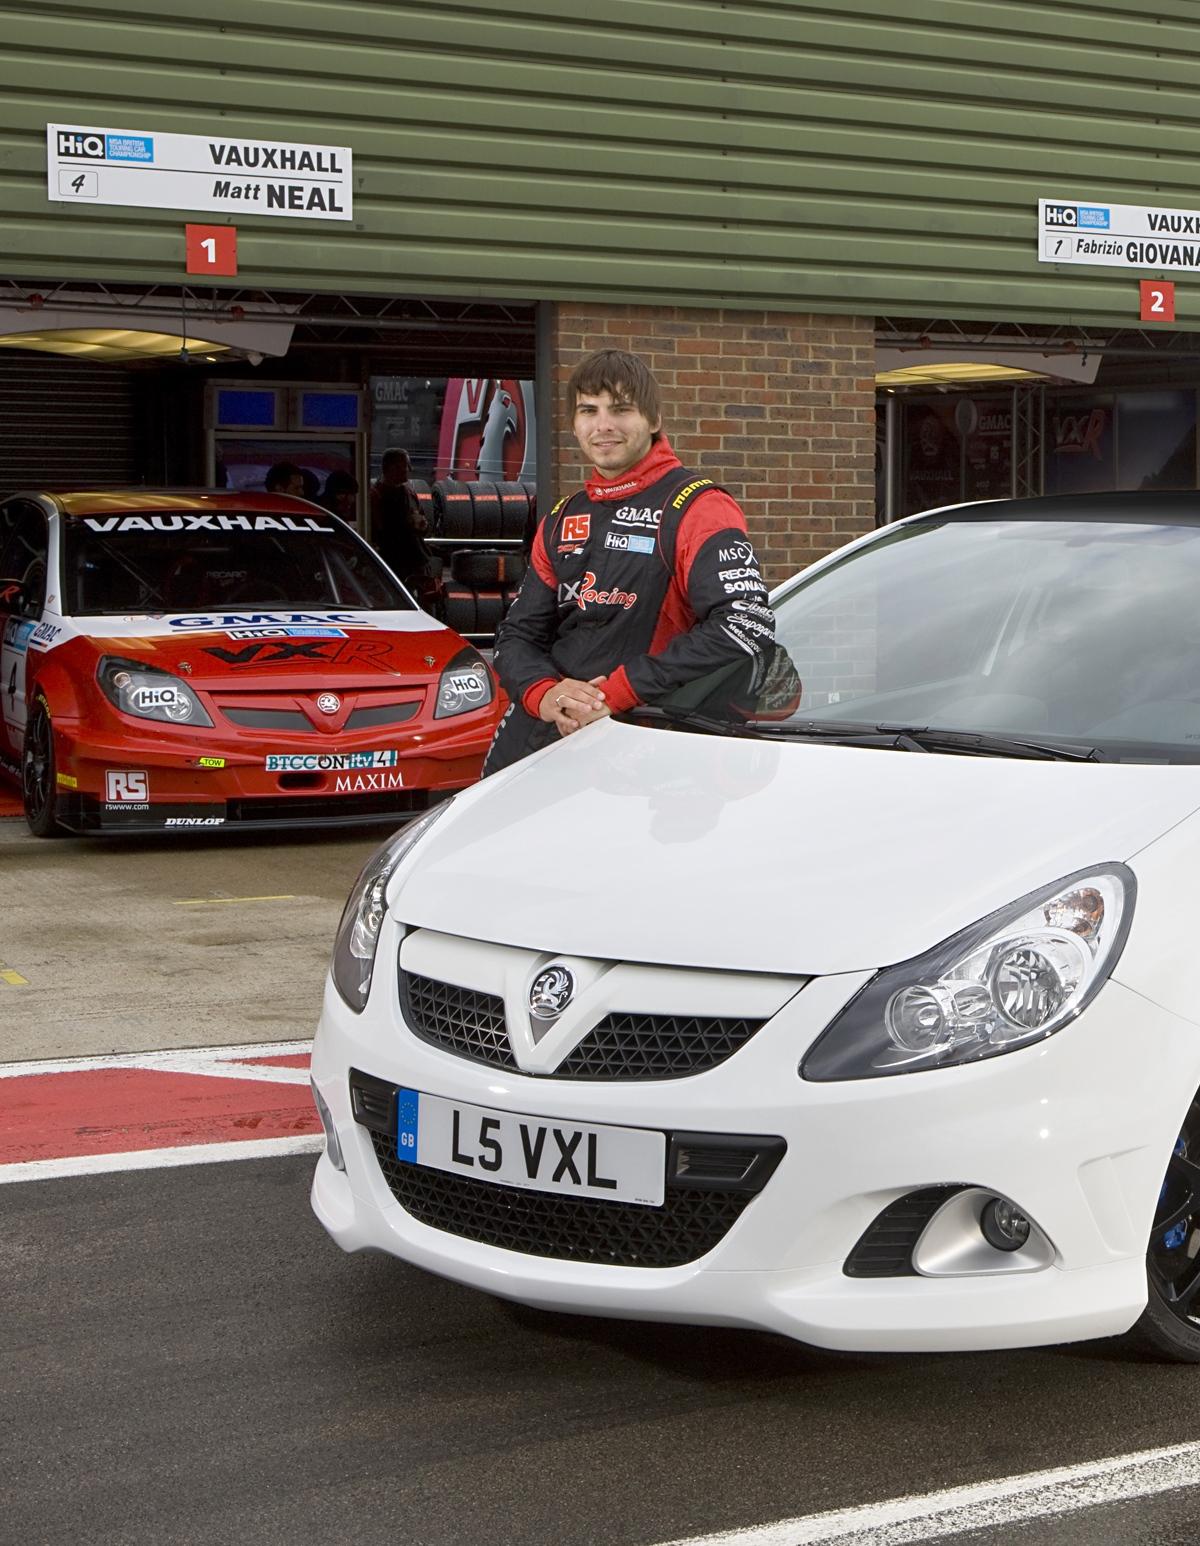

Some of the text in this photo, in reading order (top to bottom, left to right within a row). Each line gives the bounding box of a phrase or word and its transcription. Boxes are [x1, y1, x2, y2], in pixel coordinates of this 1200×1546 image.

[59, 134, 104, 157] HiQ
[209, 143, 343, 174] VAUXHALL
[71, 174, 85, 193] 4
[213, 180, 344, 212] Matt NEAL
[1046, 207, 1077, 225] HiQ
[200, 238, 216, 263] 1
[1054, 240, 1063, 255] 1
[1076, 238, 1123, 256] Fabrizio
[1151, 291, 1164, 312] 2
[375, 381, 409, 402] GMAC
[83, 515, 335, 533] VAUXHALL
[563, 517, 590, 541] RS
[605, 534, 629, 549] HiQ
[168, 614, 368, 627] GMAC
[453, 677, 479, 691] HiQ
[141, 689, 176, 704] HiQ
[203, 758, 222, 766] TOW
[107, 772, 147, 801] RS
[335, 772, 404, 792] MAXIM
[105, 803, 149, 811] rswww.com
[164, 817, 225, 826] DUNLOP
[401, 1132, 415, 1148] GB
[452, 1108, 617, 1190] L5 VXL
